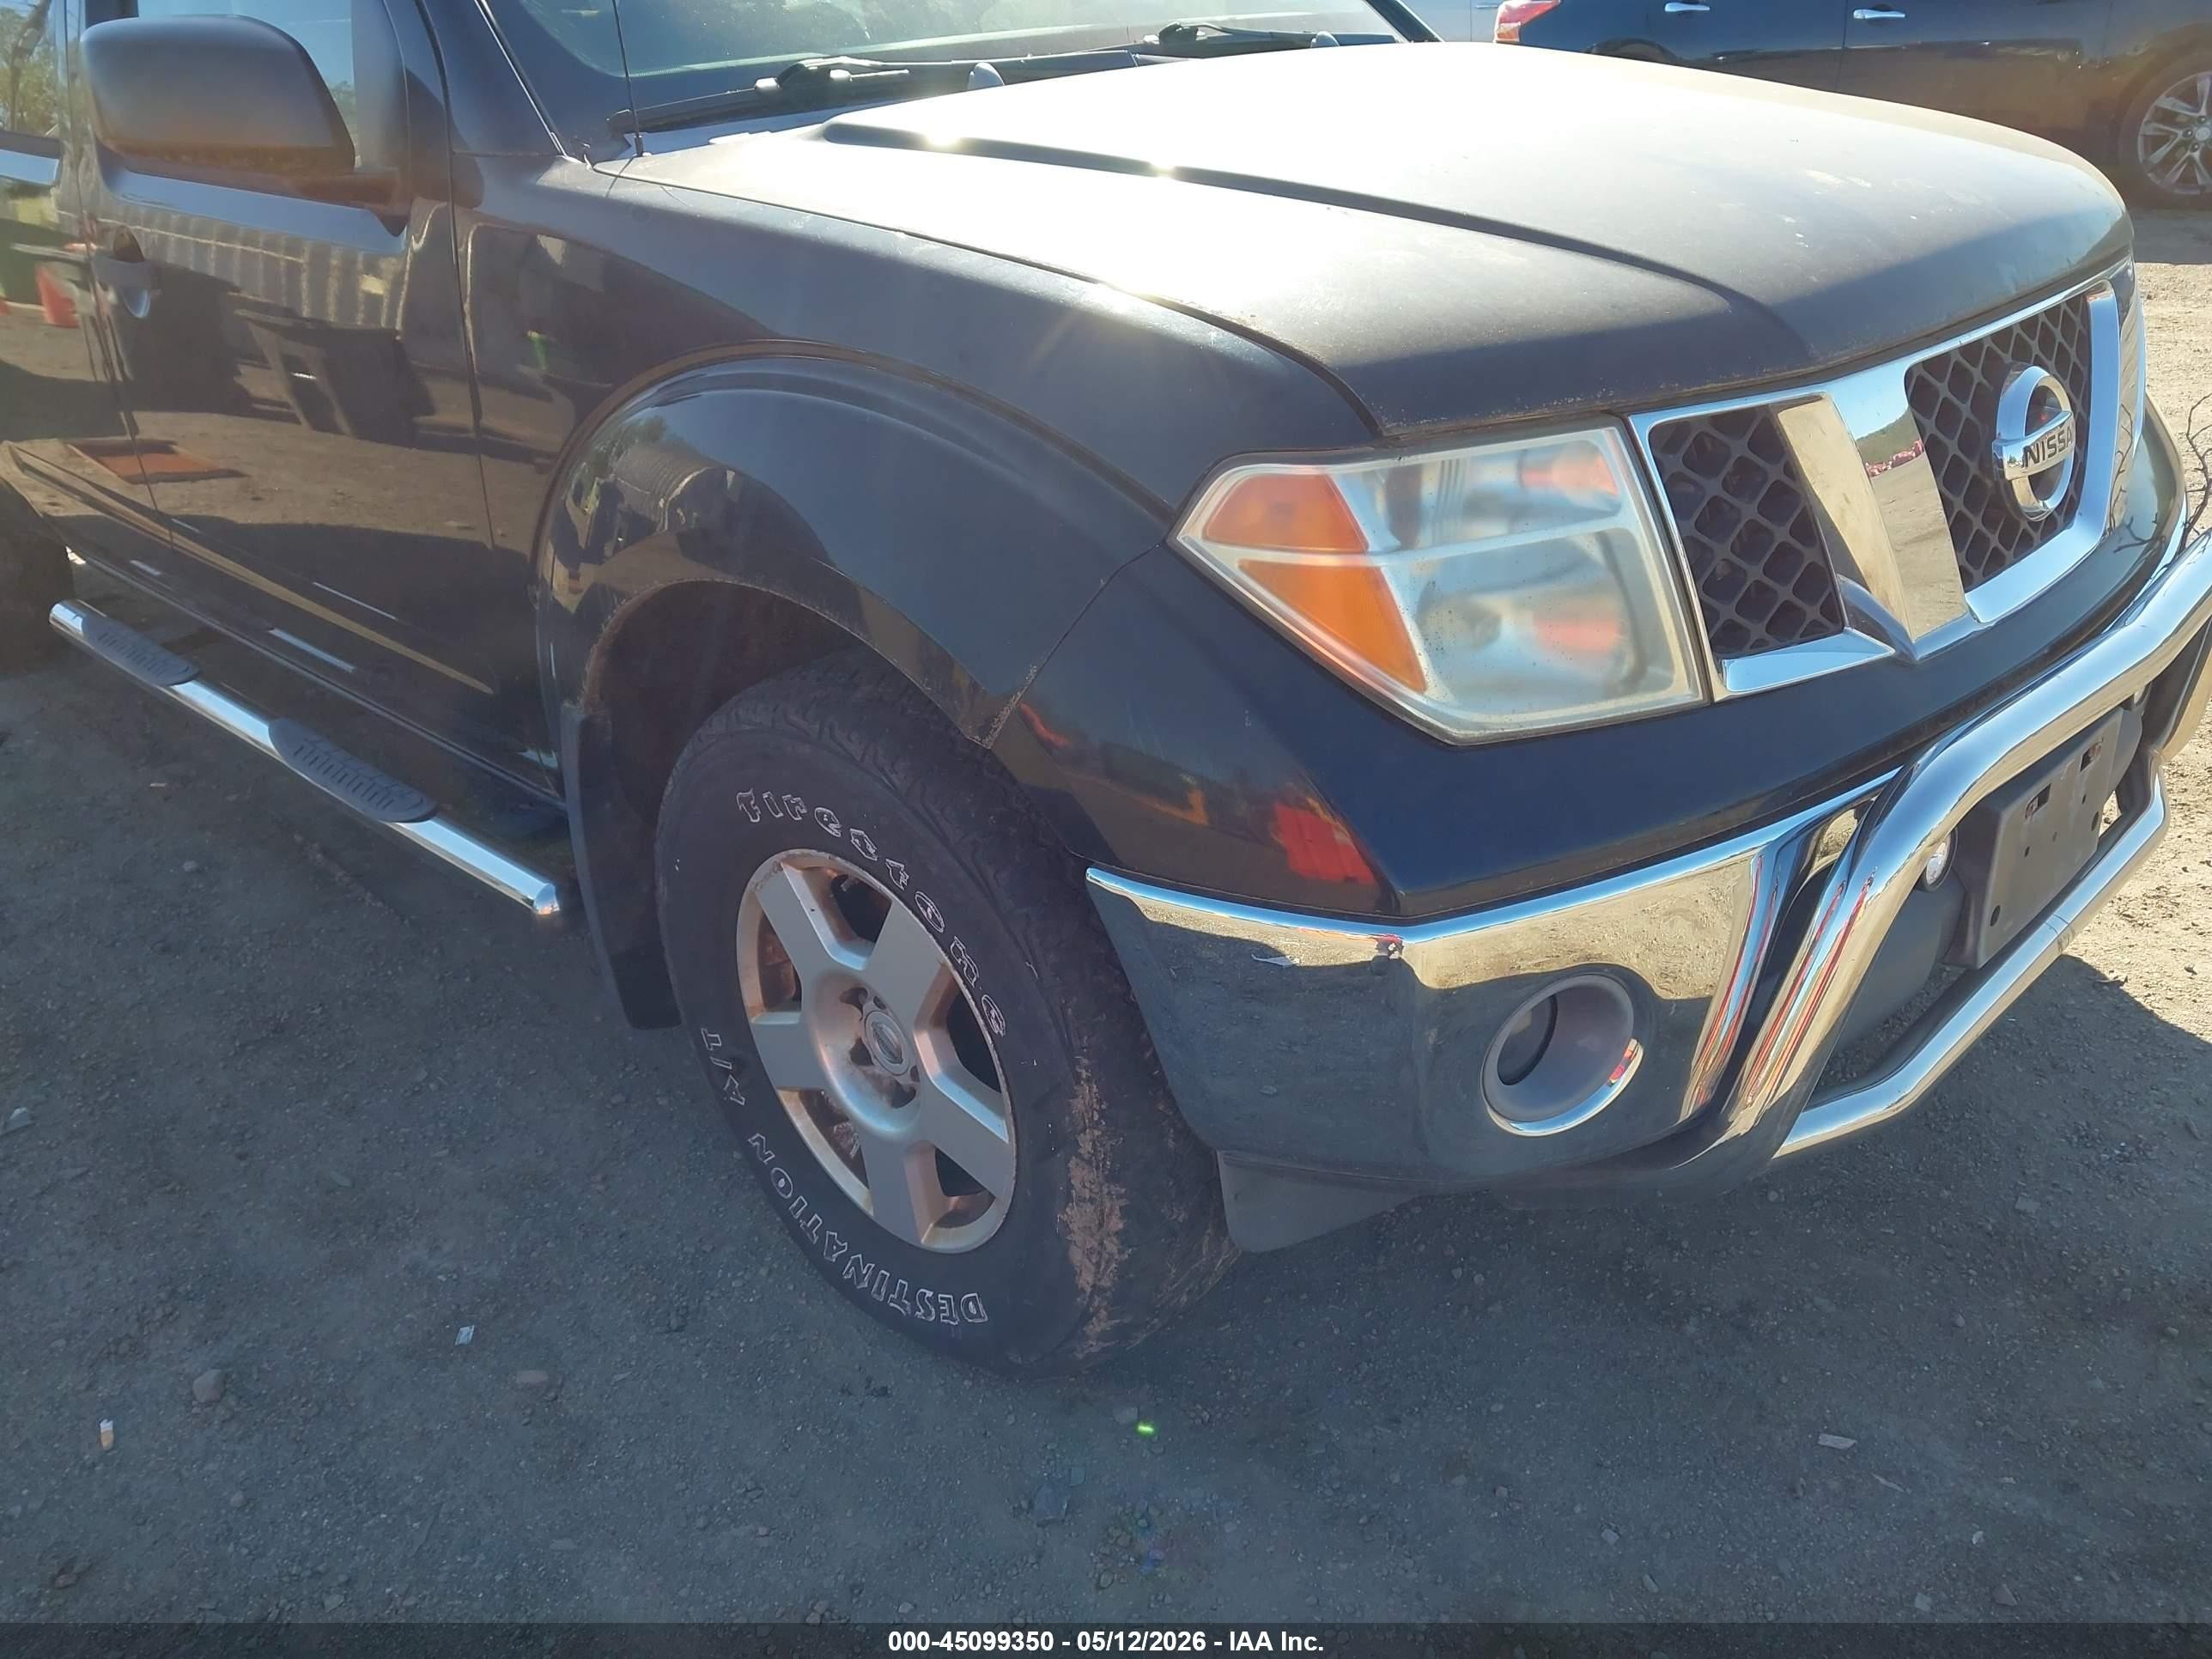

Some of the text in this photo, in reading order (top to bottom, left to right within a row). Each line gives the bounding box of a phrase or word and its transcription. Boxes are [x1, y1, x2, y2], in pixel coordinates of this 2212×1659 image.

[2021, 425, 2073, 468] NISSA
[700, 1028, 989, 1326] DESTINATION A/T
